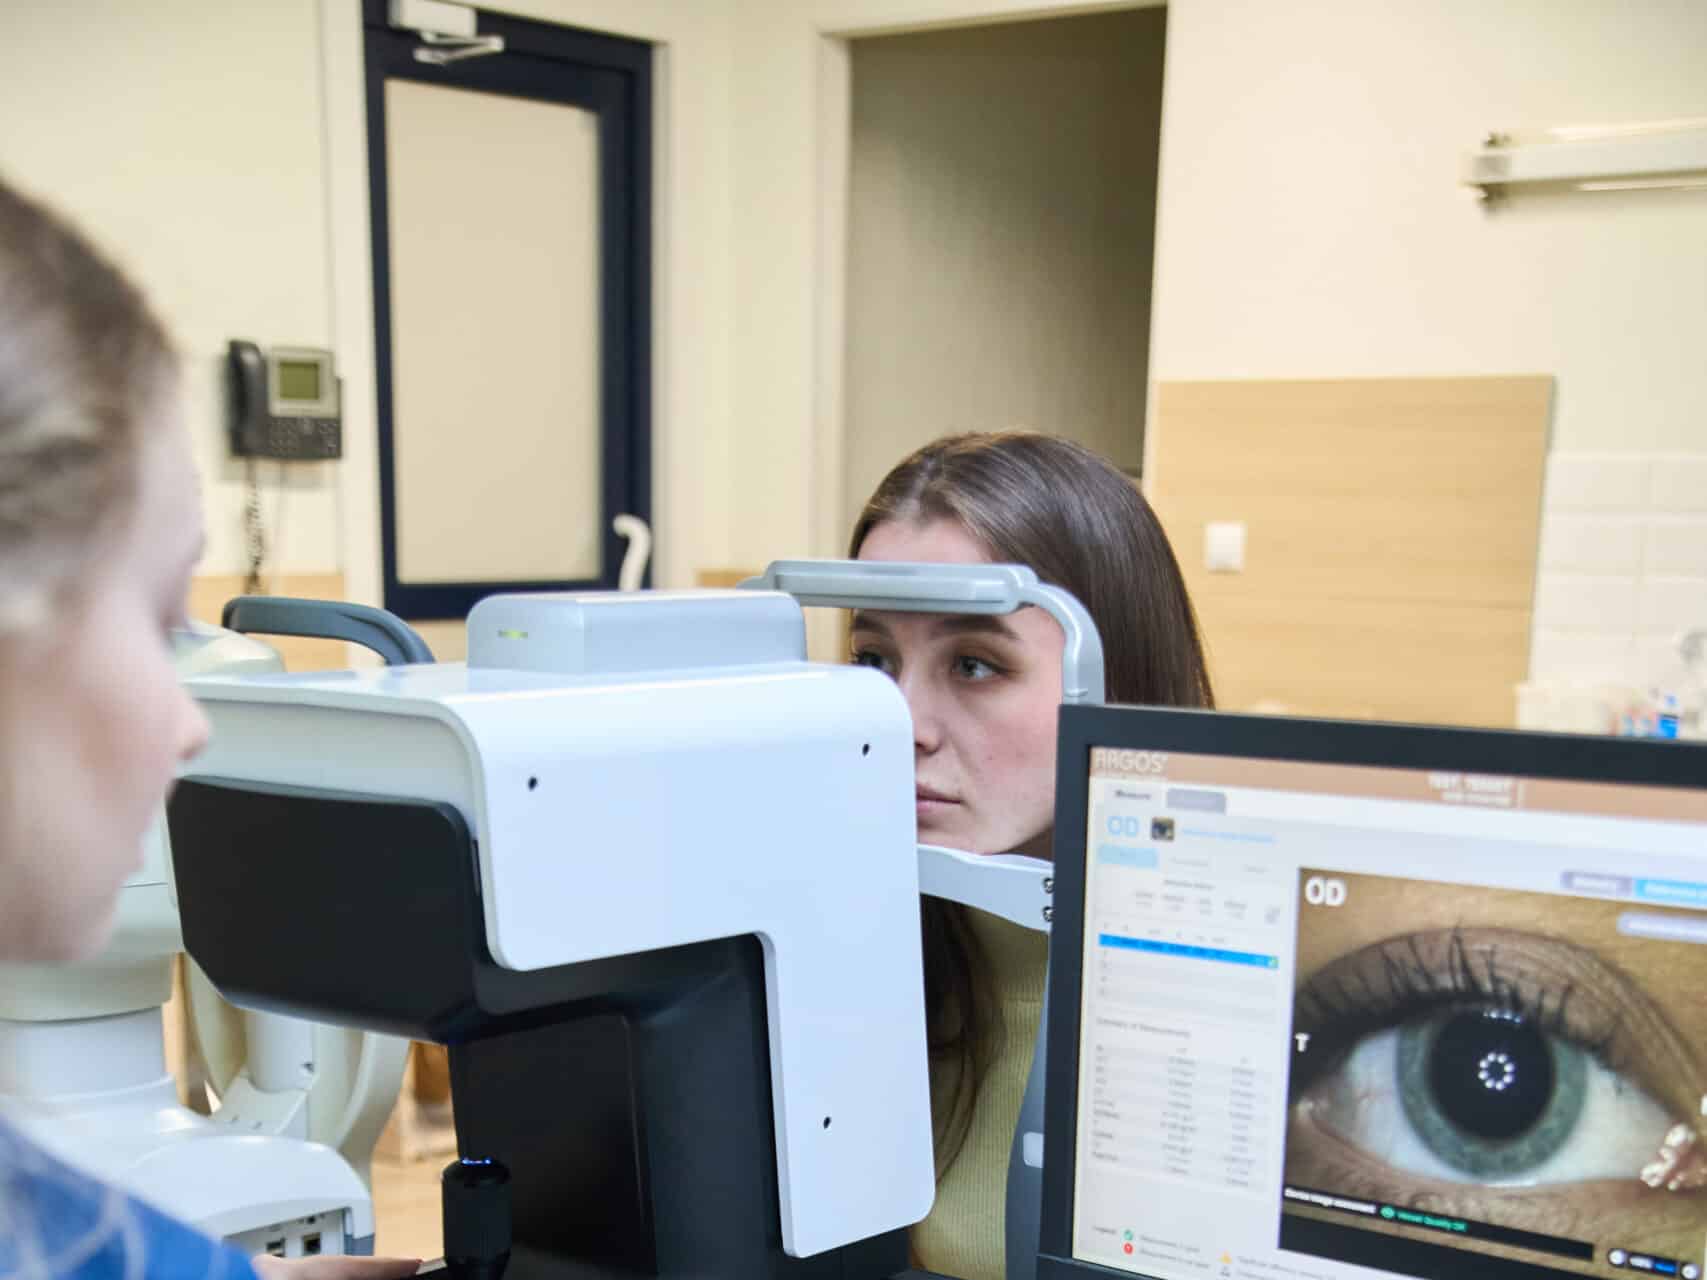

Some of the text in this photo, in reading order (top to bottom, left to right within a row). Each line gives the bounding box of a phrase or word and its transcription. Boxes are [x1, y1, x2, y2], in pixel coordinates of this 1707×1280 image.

[1106, 815, 1140, 838] OD
[1304, 876, 1347, 907] OD
[1294, 1032, 1311, 1053] T
